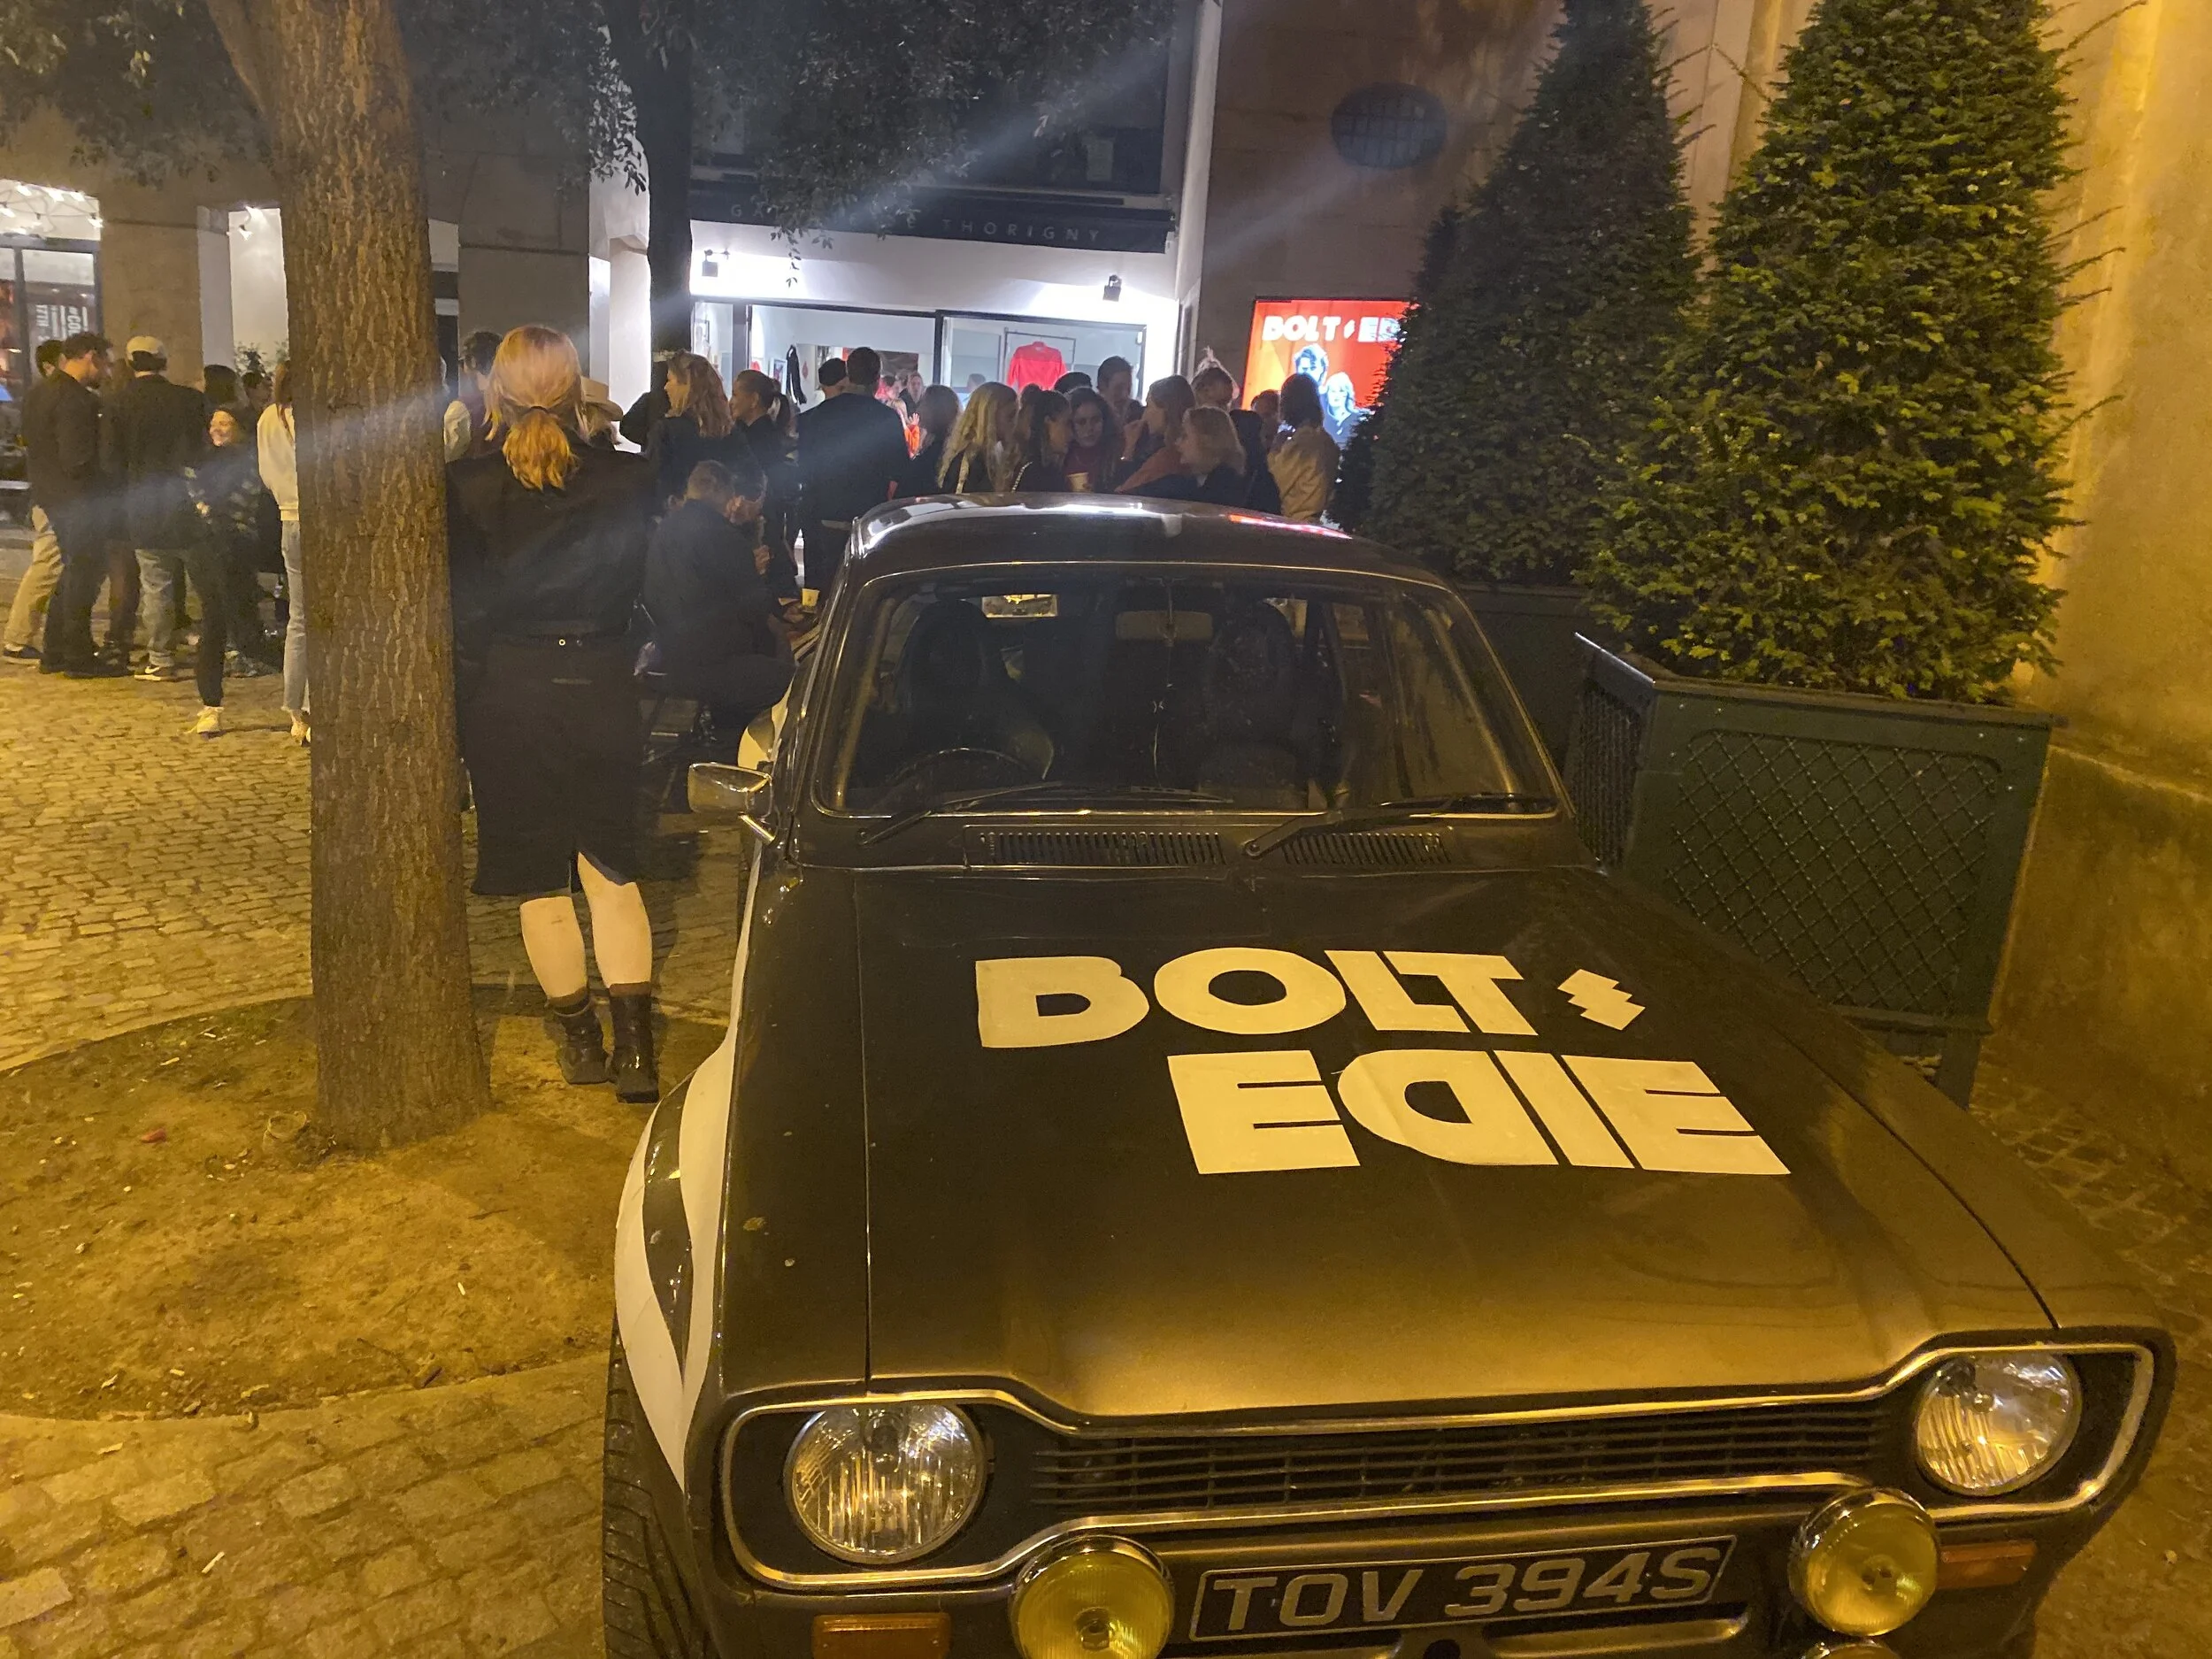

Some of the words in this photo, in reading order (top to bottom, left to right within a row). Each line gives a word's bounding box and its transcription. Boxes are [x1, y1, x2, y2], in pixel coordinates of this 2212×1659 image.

[941, 218, 1100, 242] THORIGNY
[1261, 315, 1341, 342] BOLT
[975, 947, 1539, 1048] BOLT
[1167, 1048, 1792, 1175] EDIE
[1212, 1569, 1424, 1631] TOV
[1444, 1547, 1721, 1617] 394S
